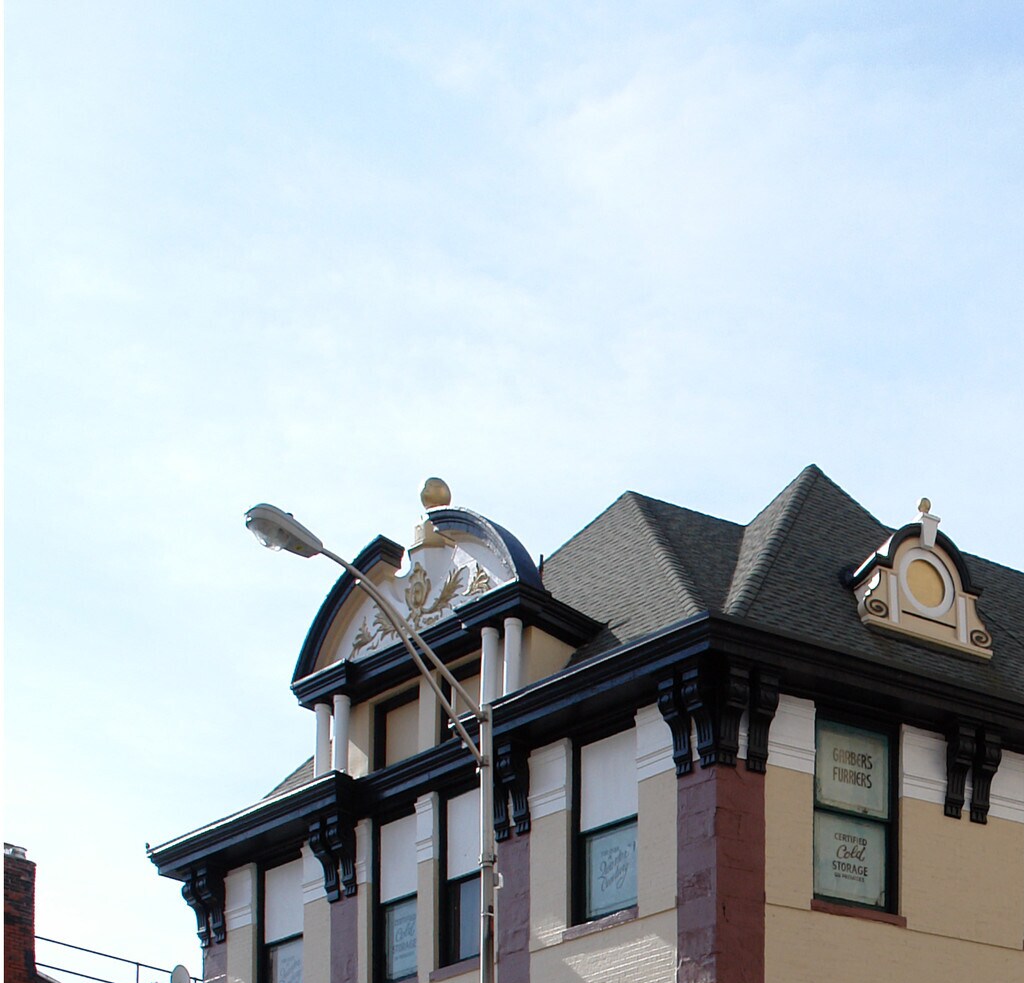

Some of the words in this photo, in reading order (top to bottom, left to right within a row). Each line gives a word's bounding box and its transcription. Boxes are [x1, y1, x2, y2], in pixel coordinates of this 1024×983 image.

[833, 766, 873, 789] FURRIERS
[834, 832, 868, 846] CERTIFIED
[836, 844, 866, 862] Cold
[832, 860, 868, 877] STORAGE
